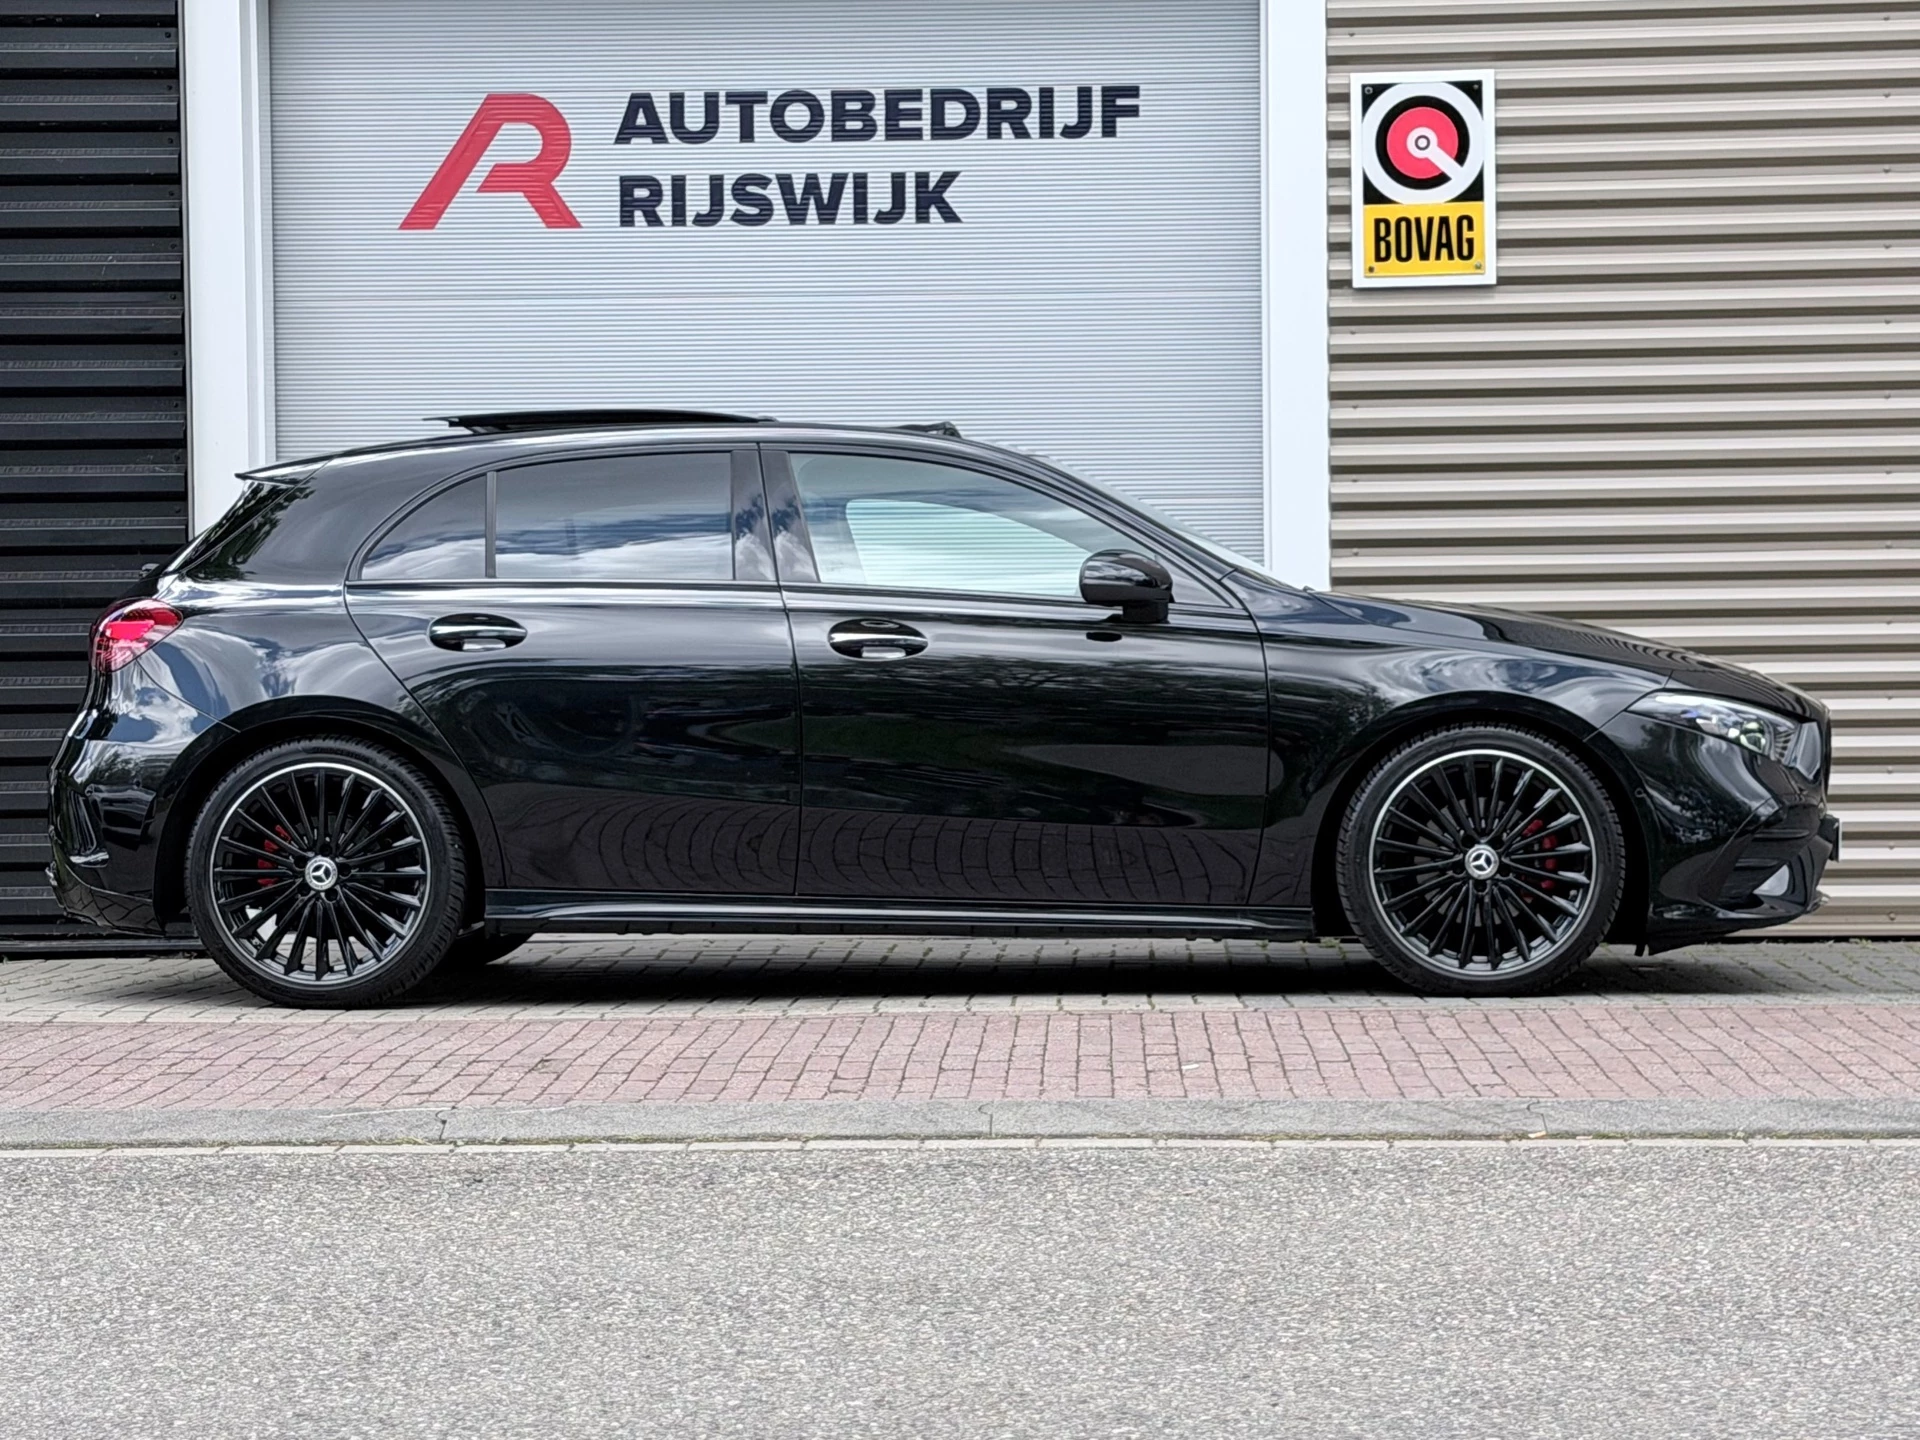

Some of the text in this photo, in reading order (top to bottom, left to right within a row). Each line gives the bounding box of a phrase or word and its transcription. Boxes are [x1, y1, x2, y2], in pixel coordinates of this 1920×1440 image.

[614, 86, 1139, 144] AUTOBEDRIJF
[620, 171, 963, 228] RIJSWIJK
[1374, 215, 1474, 262] BOVAG
